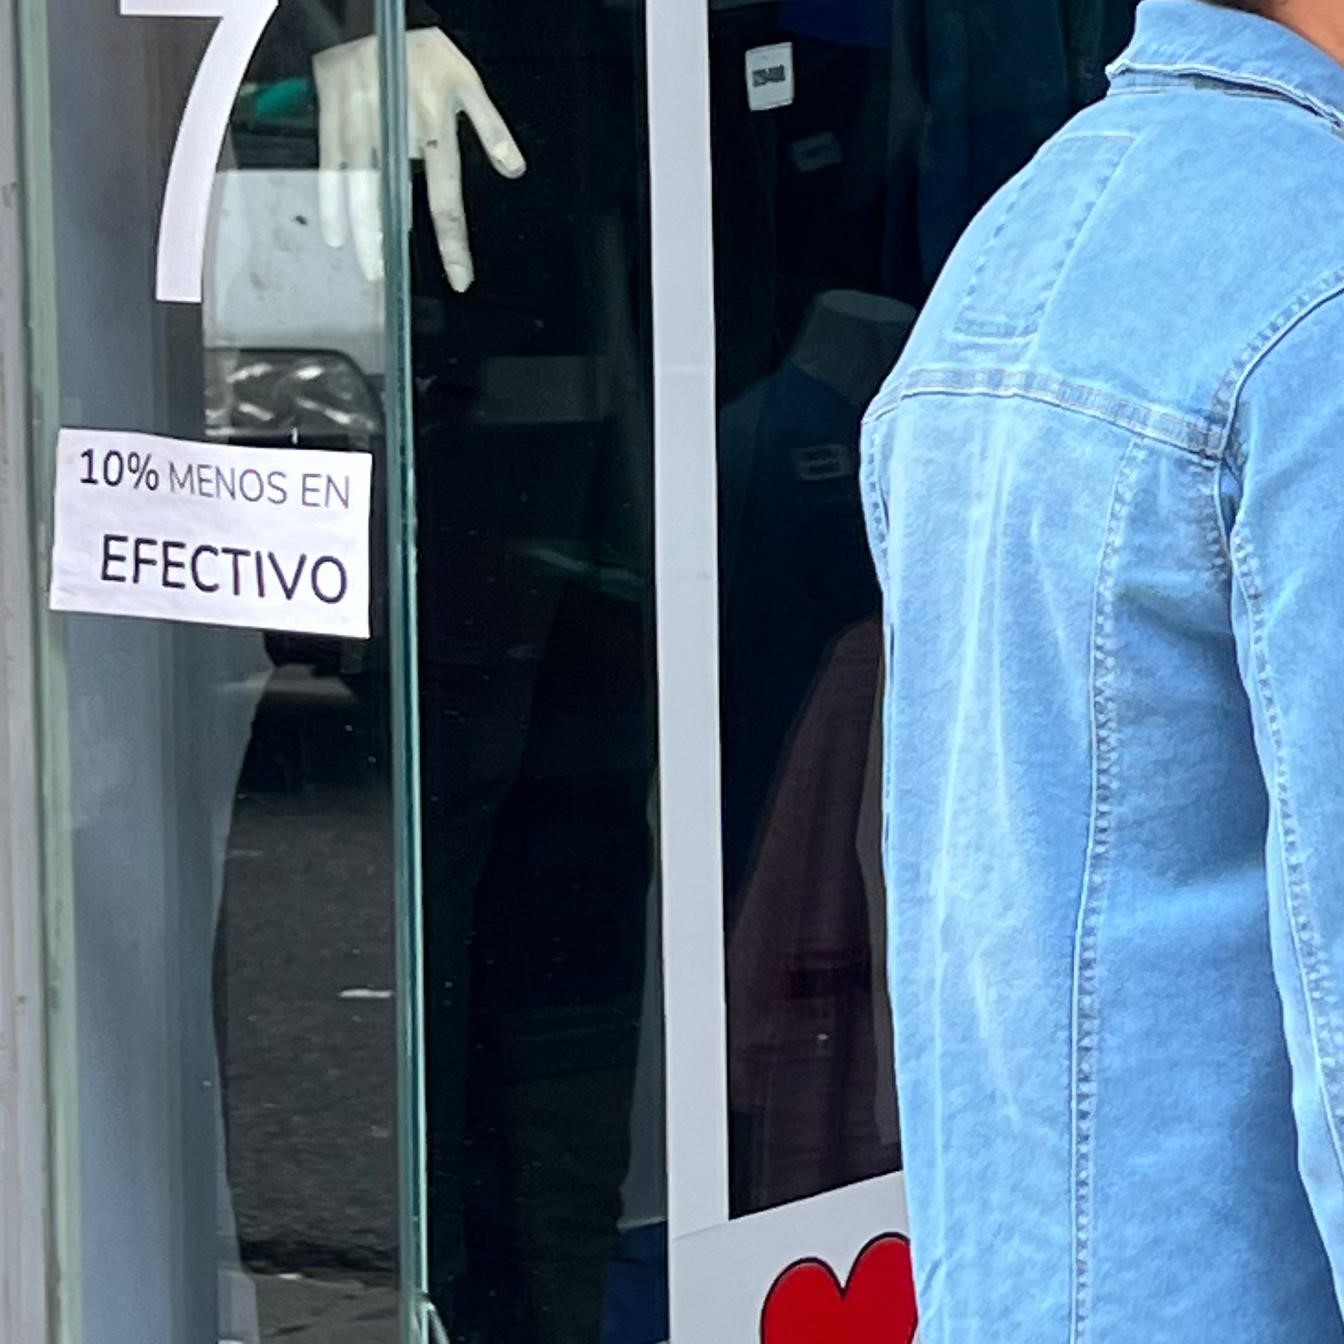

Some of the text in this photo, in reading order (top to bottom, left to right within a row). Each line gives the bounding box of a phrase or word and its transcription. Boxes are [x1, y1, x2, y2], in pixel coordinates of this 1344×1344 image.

[79, 447, 350, 510] 10% MENOS EN
[100, 533, 348, 604] EFECTIVO
